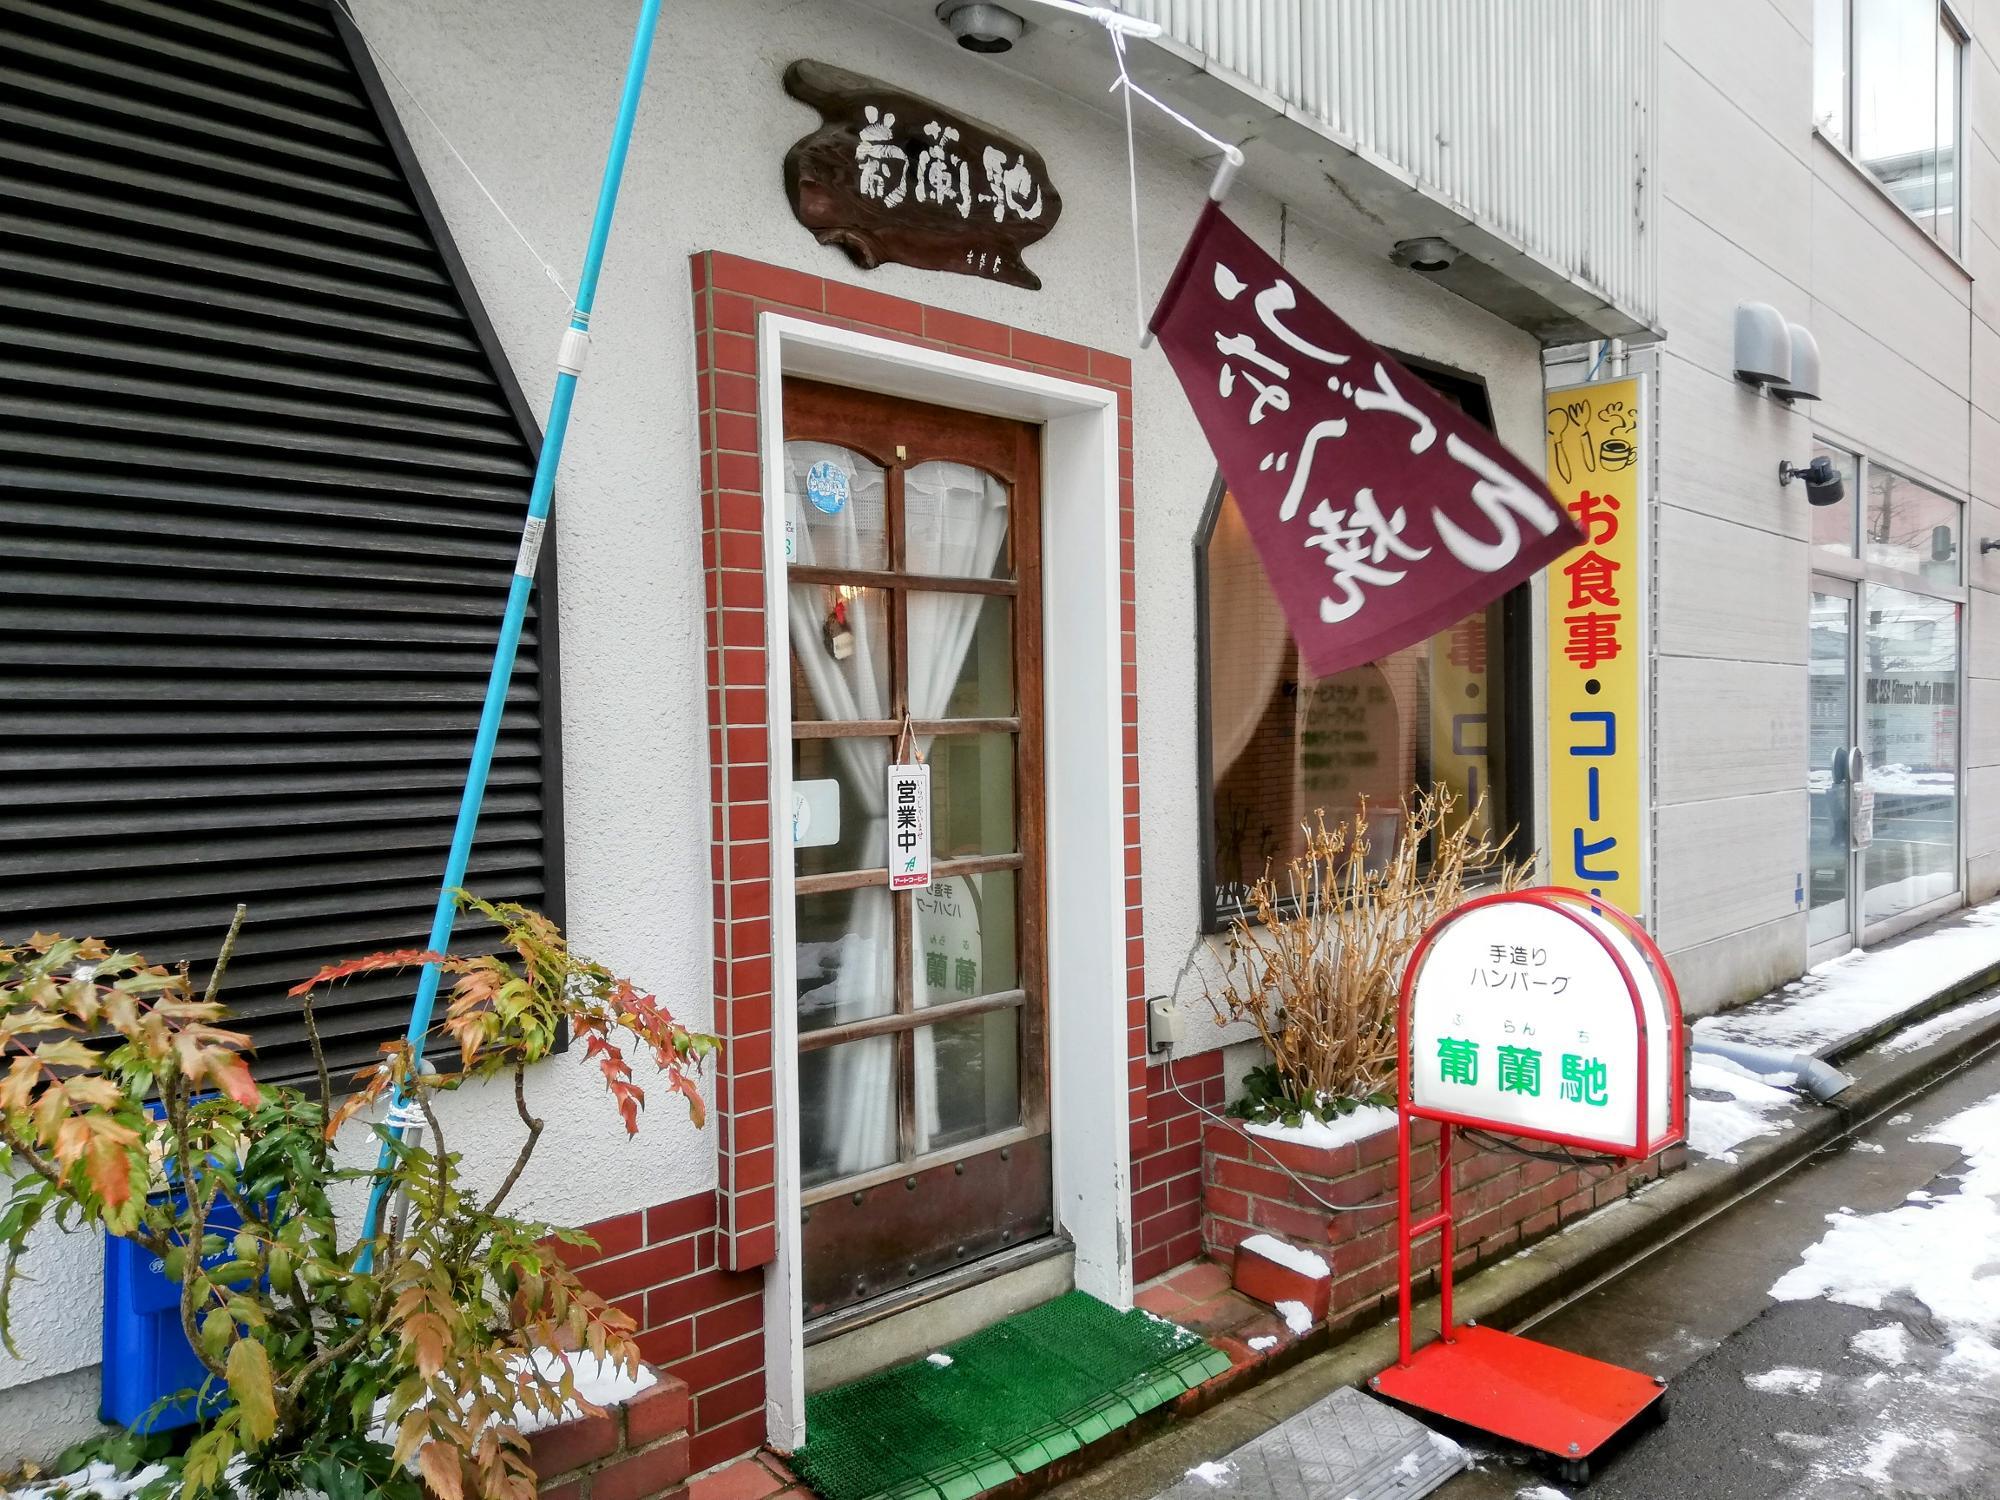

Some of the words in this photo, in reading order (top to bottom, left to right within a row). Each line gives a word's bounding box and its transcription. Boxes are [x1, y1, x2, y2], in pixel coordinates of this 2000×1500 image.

[897, 780, 917, 853] 営業中
[895, 875, 928, 885] アートコーヒー
[1489, 944, 1547, 966] 手造り
[1470, 967, 1571, 995] ハンバーグ
[1437, 1036, 1609, 1107] 葡蘭馳
